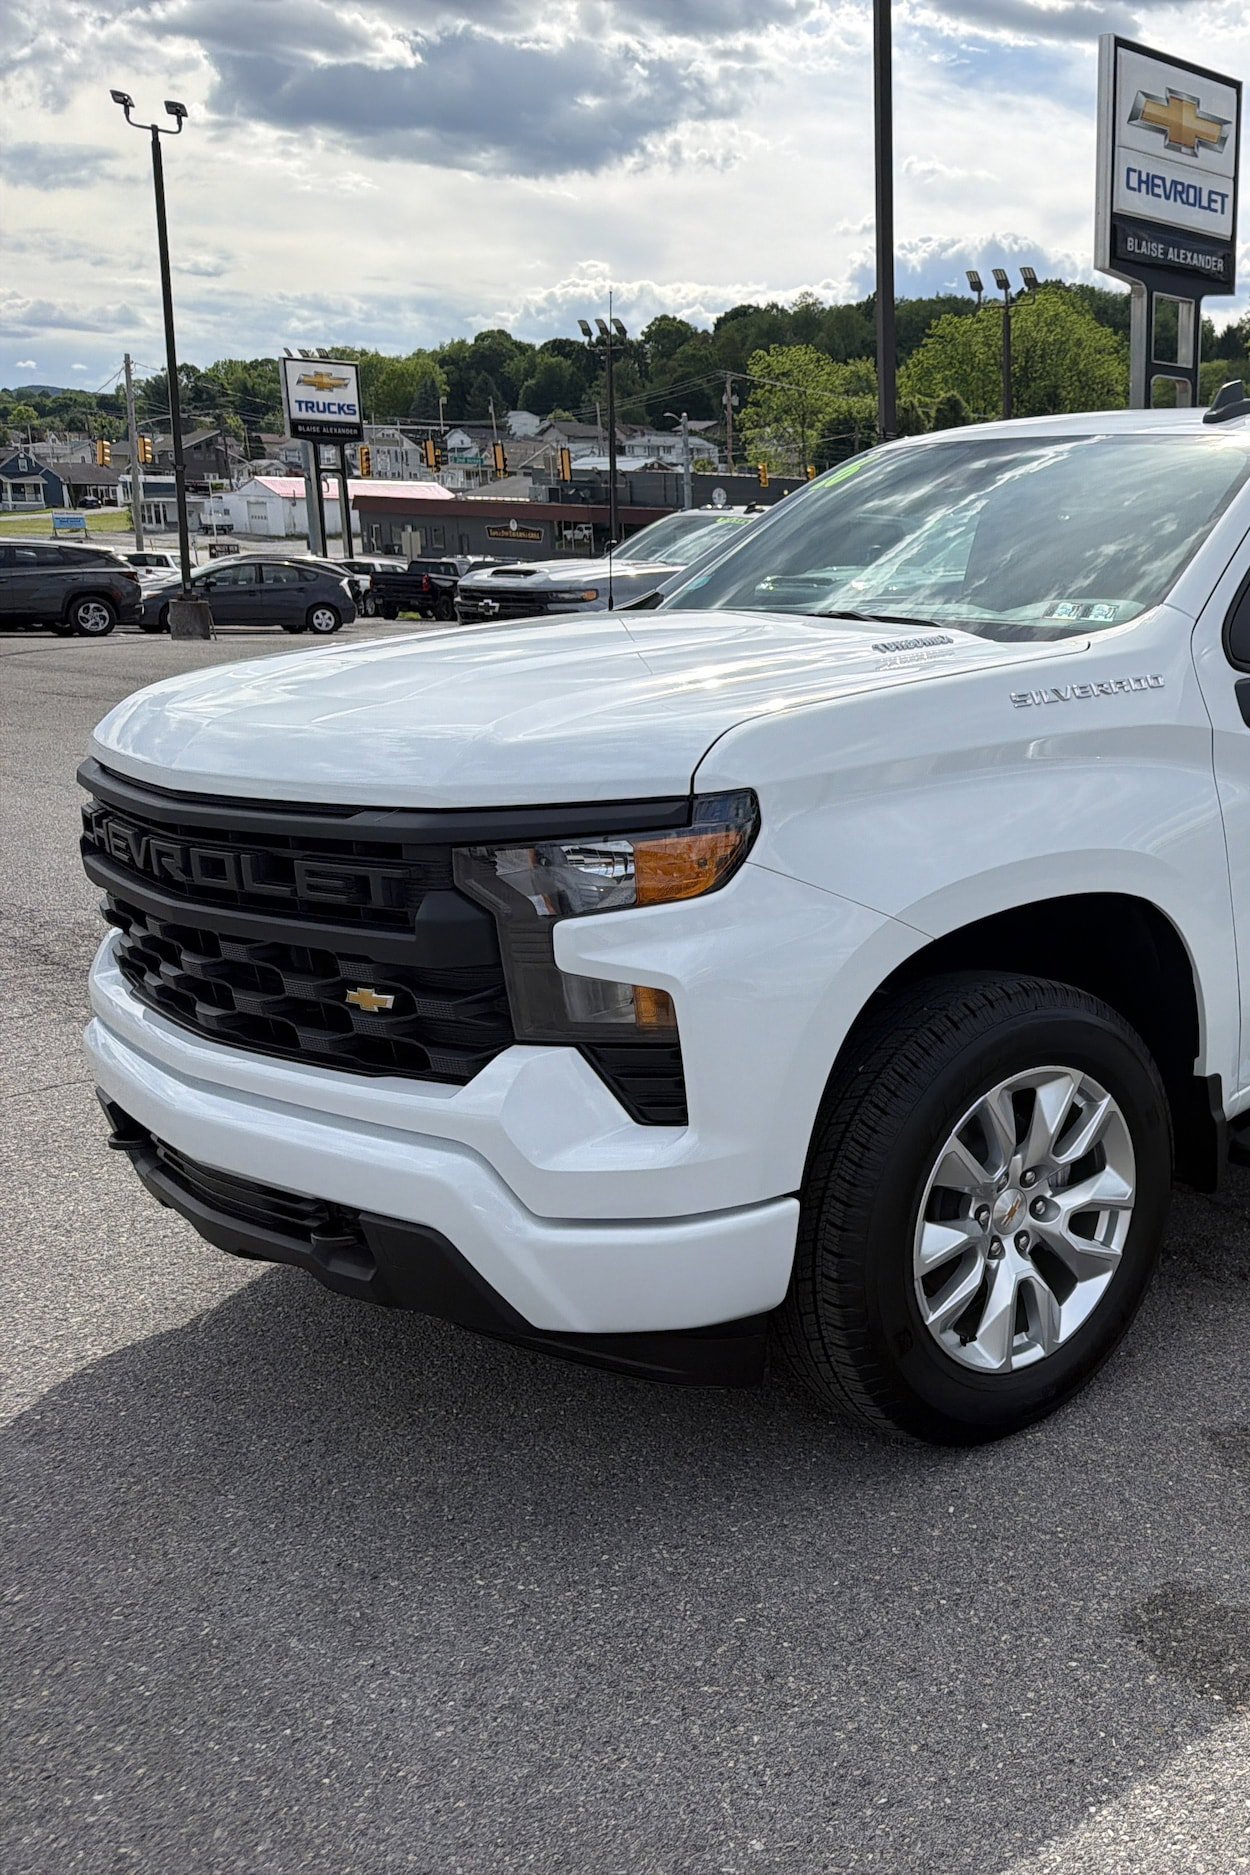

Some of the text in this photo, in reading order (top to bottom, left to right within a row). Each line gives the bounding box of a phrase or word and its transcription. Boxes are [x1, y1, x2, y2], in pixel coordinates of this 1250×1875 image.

[1125, 166, 1229, 215] CHEVROLET
[1127, 237, 1224, 272] BLAISE ALEXANDER
[295, 400, 356, 415] TRUCKS
[298, 425, 358, 435] BLAISE ALEXANDER
[1010, 674, 1165, 708] SILVERADO
[80, 803, 410, 906] CHEVROLET
